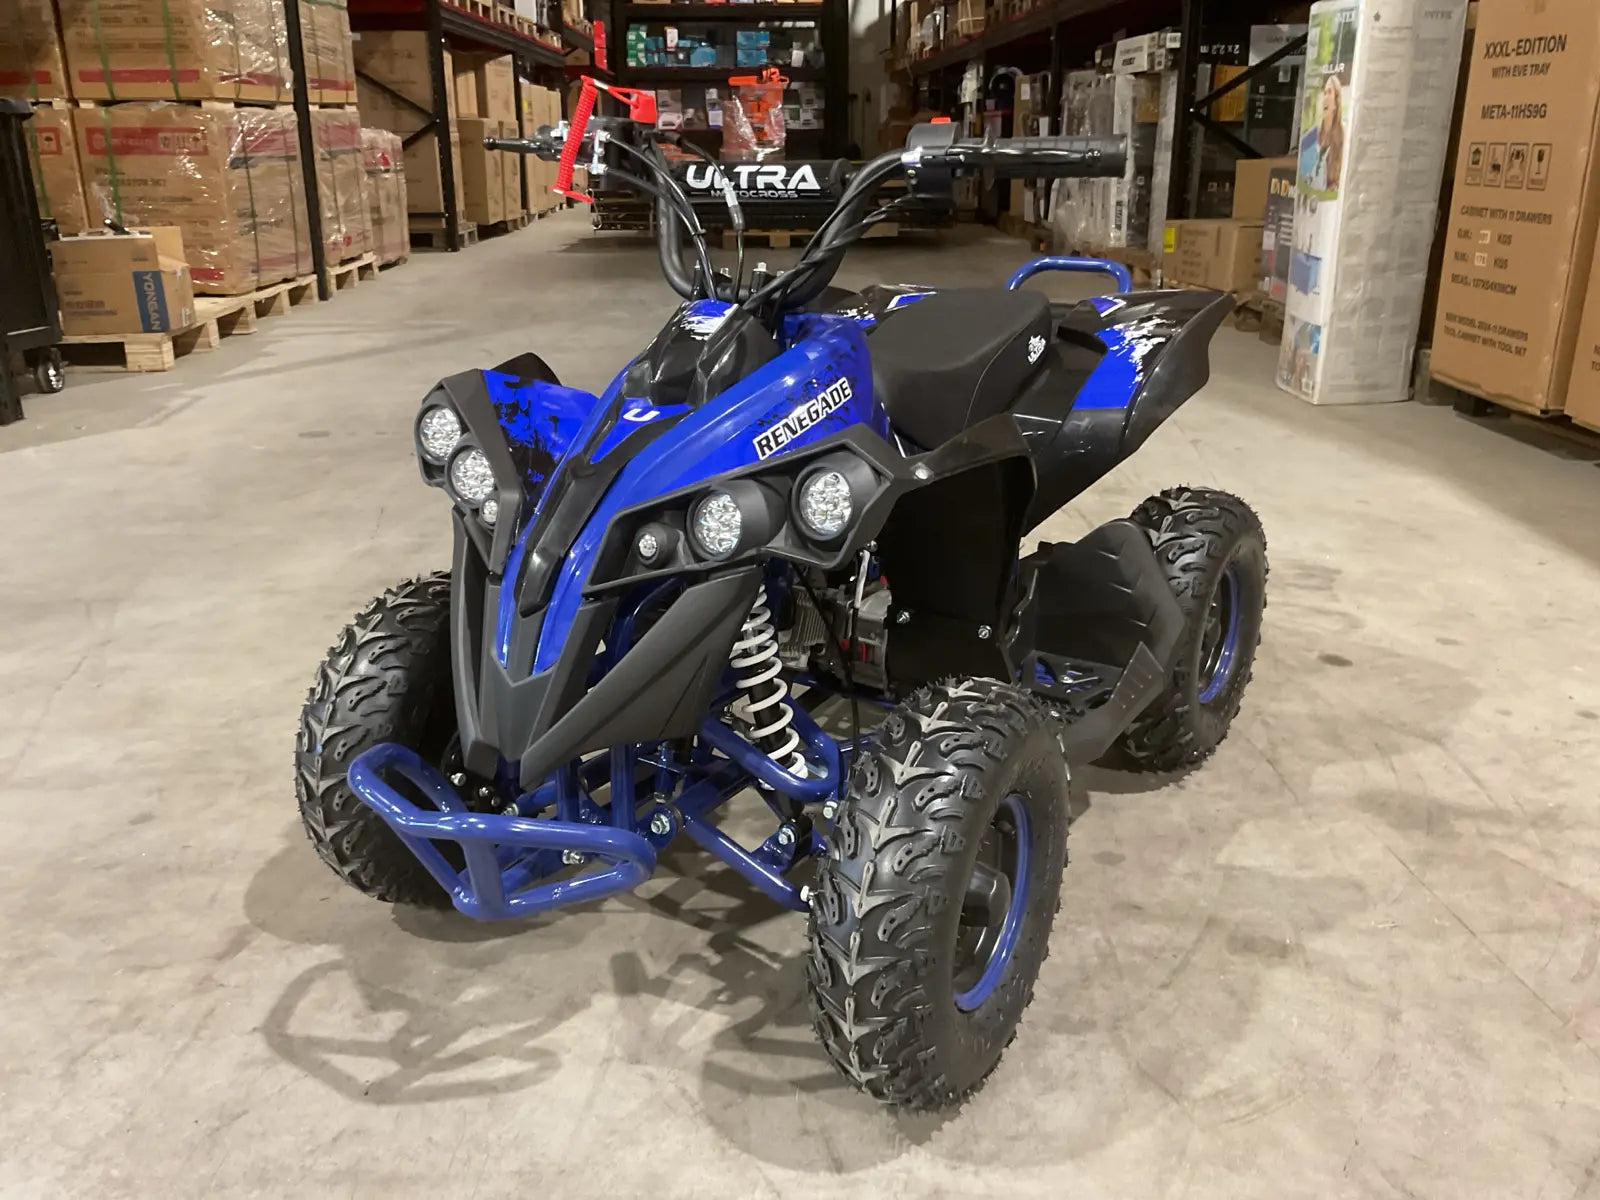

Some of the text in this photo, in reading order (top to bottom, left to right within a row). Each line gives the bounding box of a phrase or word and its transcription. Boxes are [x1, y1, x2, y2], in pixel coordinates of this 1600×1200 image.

[1484, 34, 1567, 59] XXXL-EDITION
[1492, 62, 1551, 78] WITH EVE TRAY
[686, 164, 821, 189] ULTRA
[711, 190, 798, 198] MOCROSS
[754, 378, 851, 459] RENEGADE
